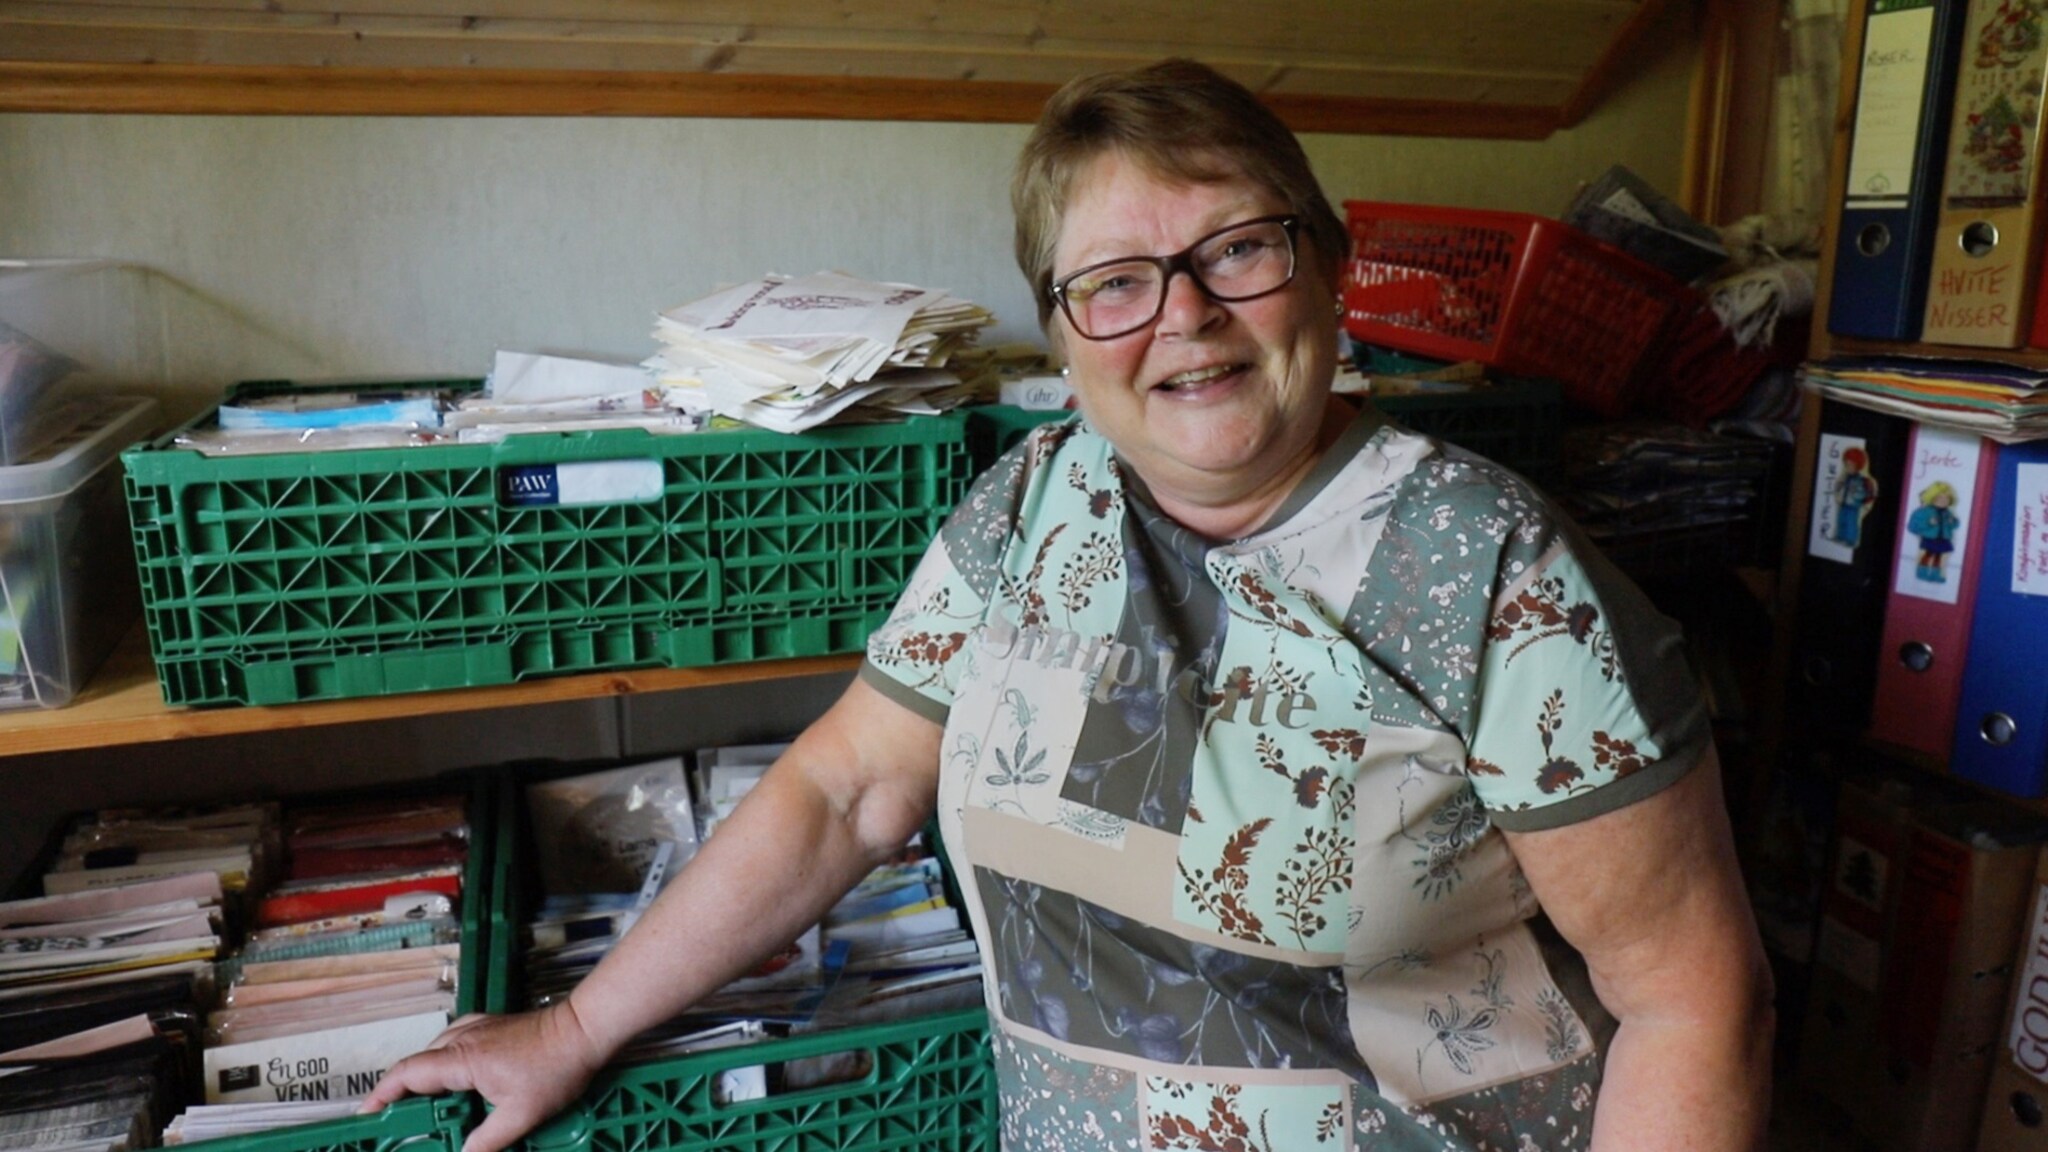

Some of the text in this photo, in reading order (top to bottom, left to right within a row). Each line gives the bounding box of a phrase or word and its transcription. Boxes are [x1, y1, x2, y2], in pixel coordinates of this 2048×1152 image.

[508, 474, 551, 491] PAW
[266, 1057, 296, 1088] En
[296, 1057, 329, 1079] GOD
